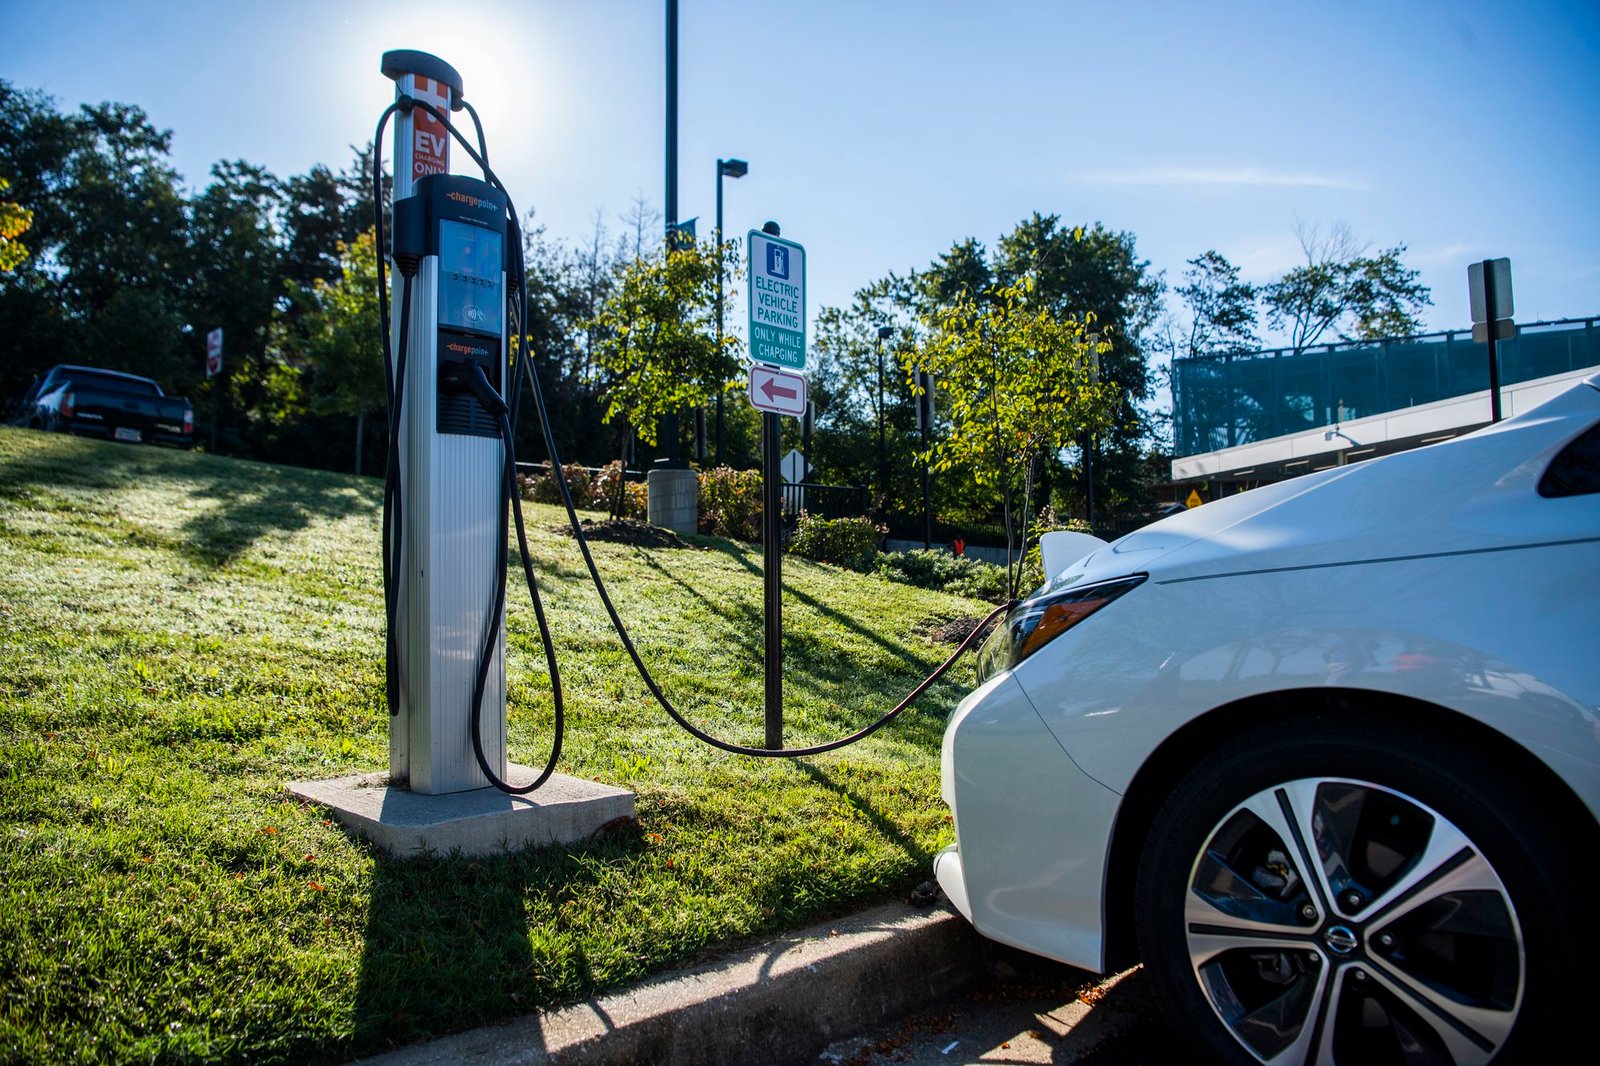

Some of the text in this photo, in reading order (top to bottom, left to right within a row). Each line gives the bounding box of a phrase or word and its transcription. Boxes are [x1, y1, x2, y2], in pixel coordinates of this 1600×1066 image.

[416, 130, 445, 157] EV
[756, 276, 799, 298] ELECTRIC
[758, 292, 797, 313] VEHICLE
[758, 307, 798, 328] PARKING
[755, 327, 801, 349] ONLY WHILE
[759, 344, 797, 362] CHARGING
